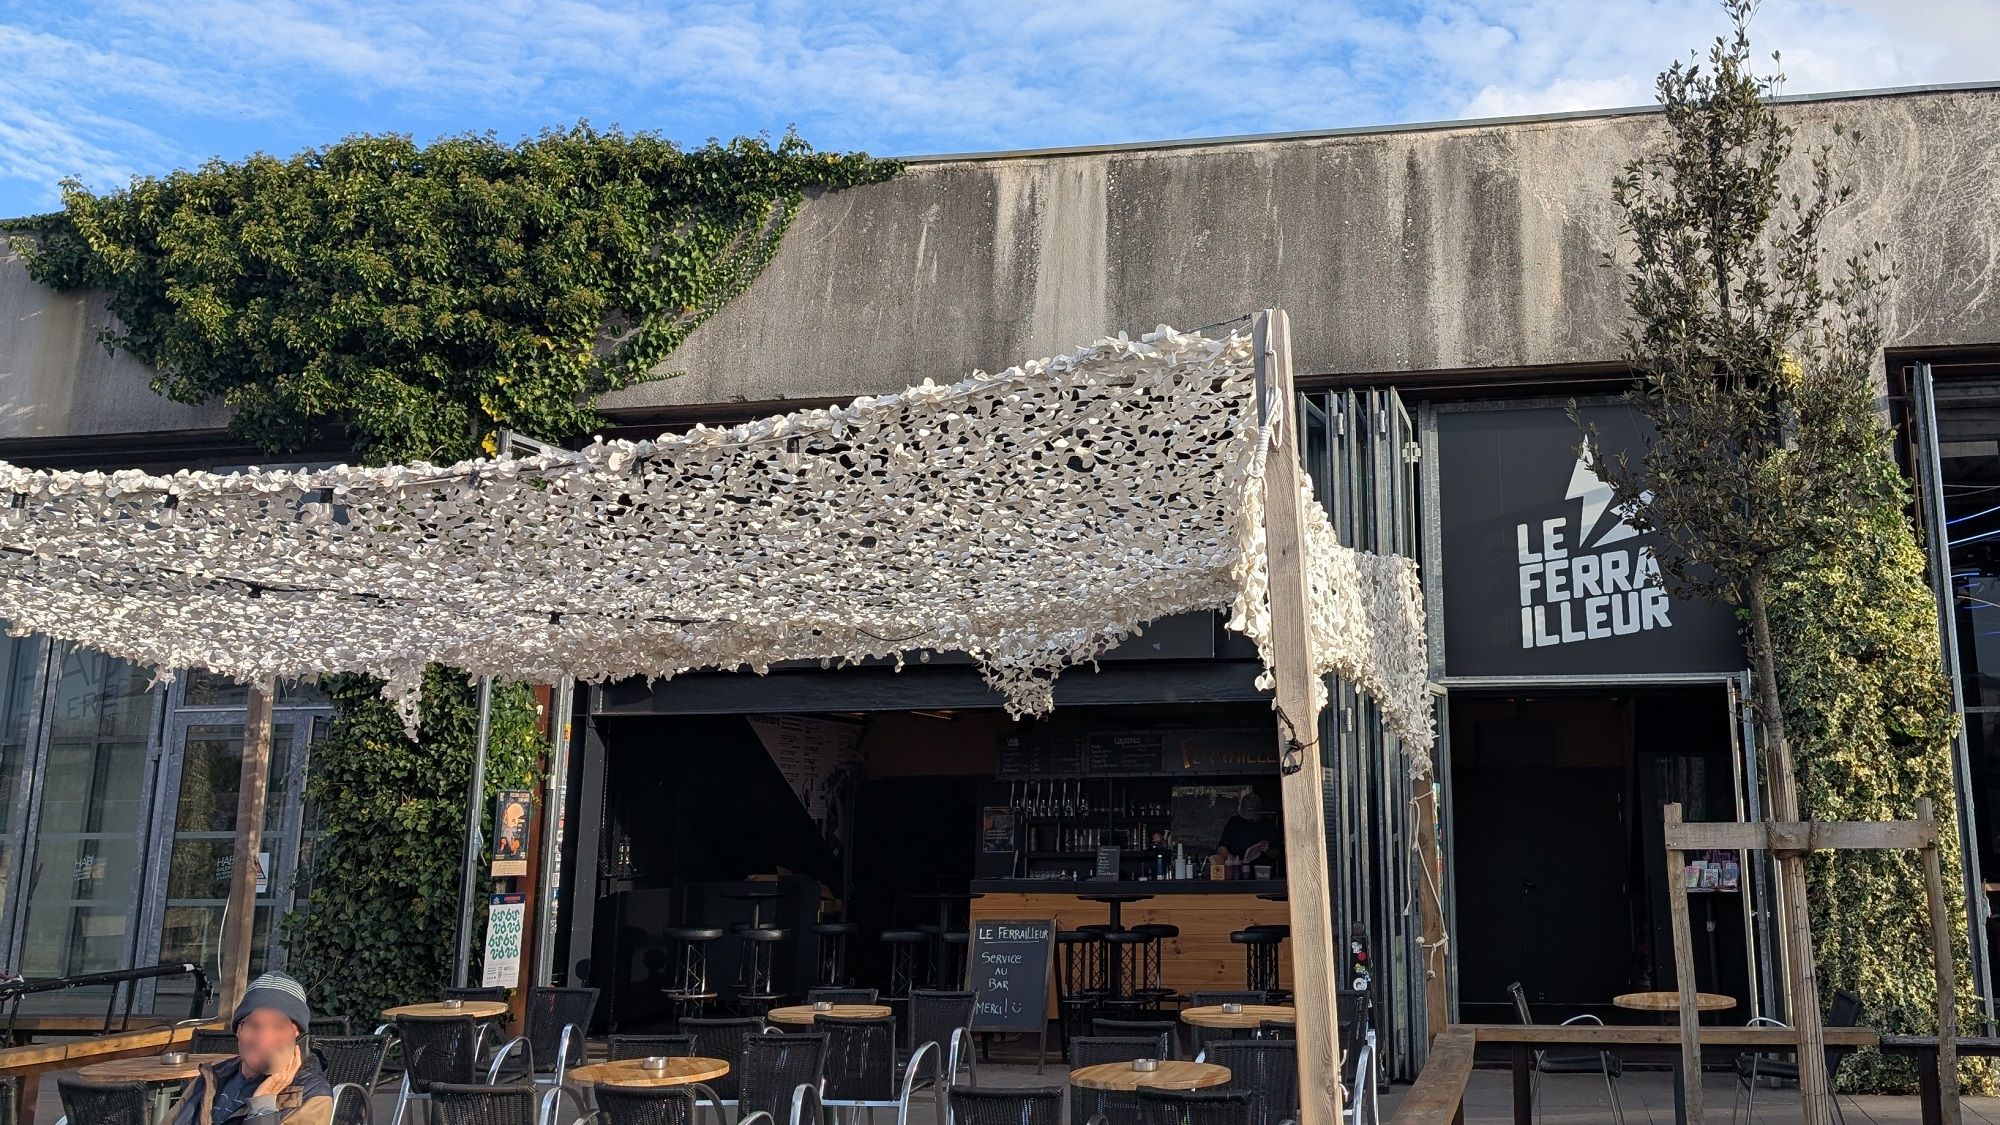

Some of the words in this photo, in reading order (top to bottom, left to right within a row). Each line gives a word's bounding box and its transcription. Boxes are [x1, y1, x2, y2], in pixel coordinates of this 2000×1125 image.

[1517, 517, 1568, 564] LE
[1519, 545, 1668, 606] FERRA
[1521, 587, 1673, 648] ILLEUR
[1179, 736, 1278, 769] FERRAILLE
[979, 928, 994, 940] LE
[988, 978, 1009, 991] BAR
[994, 967, 1008, 975] AU
